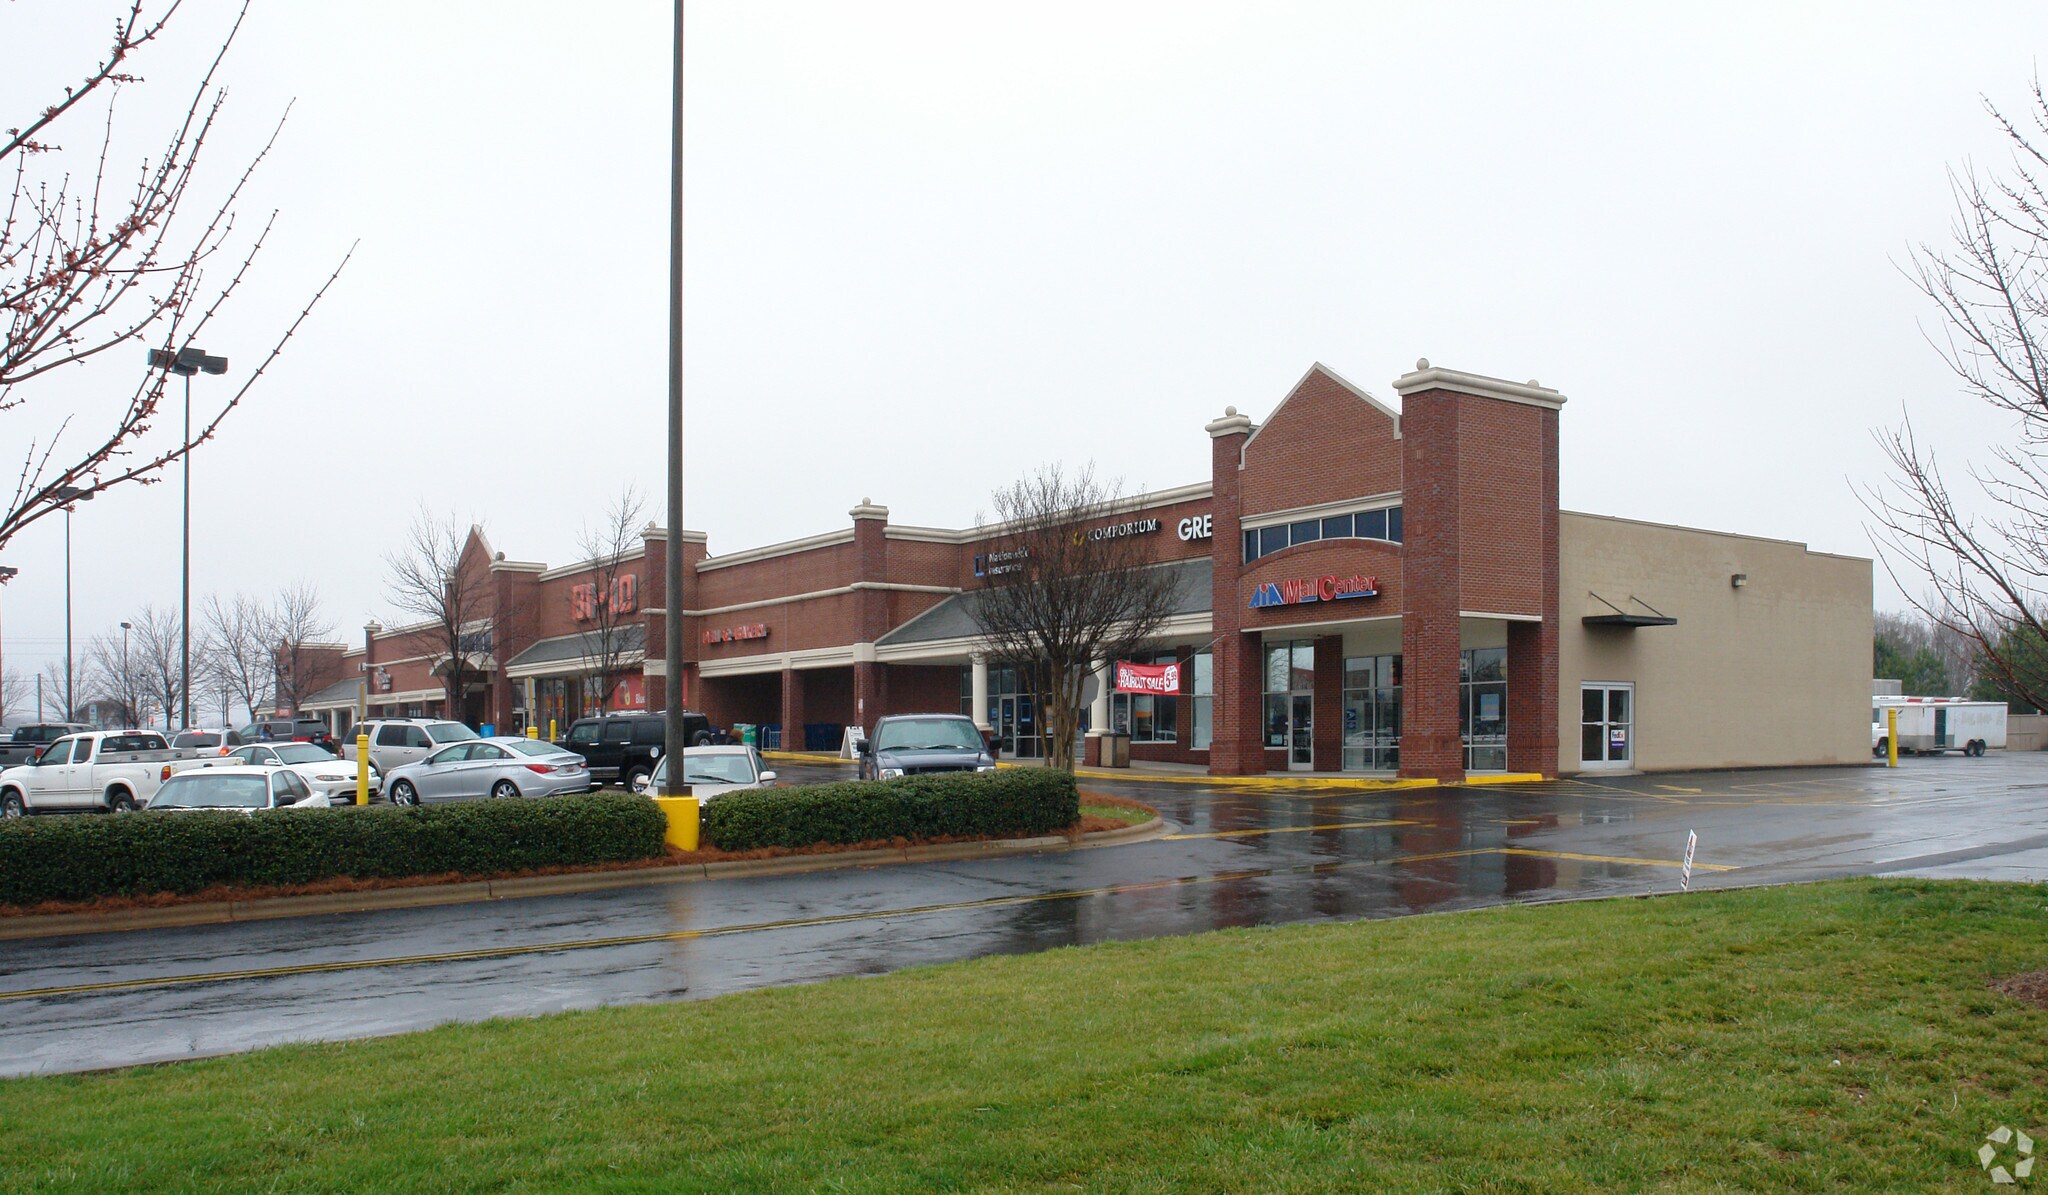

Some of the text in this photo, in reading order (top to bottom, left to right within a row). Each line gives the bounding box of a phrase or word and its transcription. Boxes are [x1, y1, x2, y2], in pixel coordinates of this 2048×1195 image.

[1088, 519, 1158, 541] COMPORIUM
[1284, 579, 1318, 604] Mail
[1319, 574, 1377, 601] Center
[1147, 676, 1163, 690] SALE
